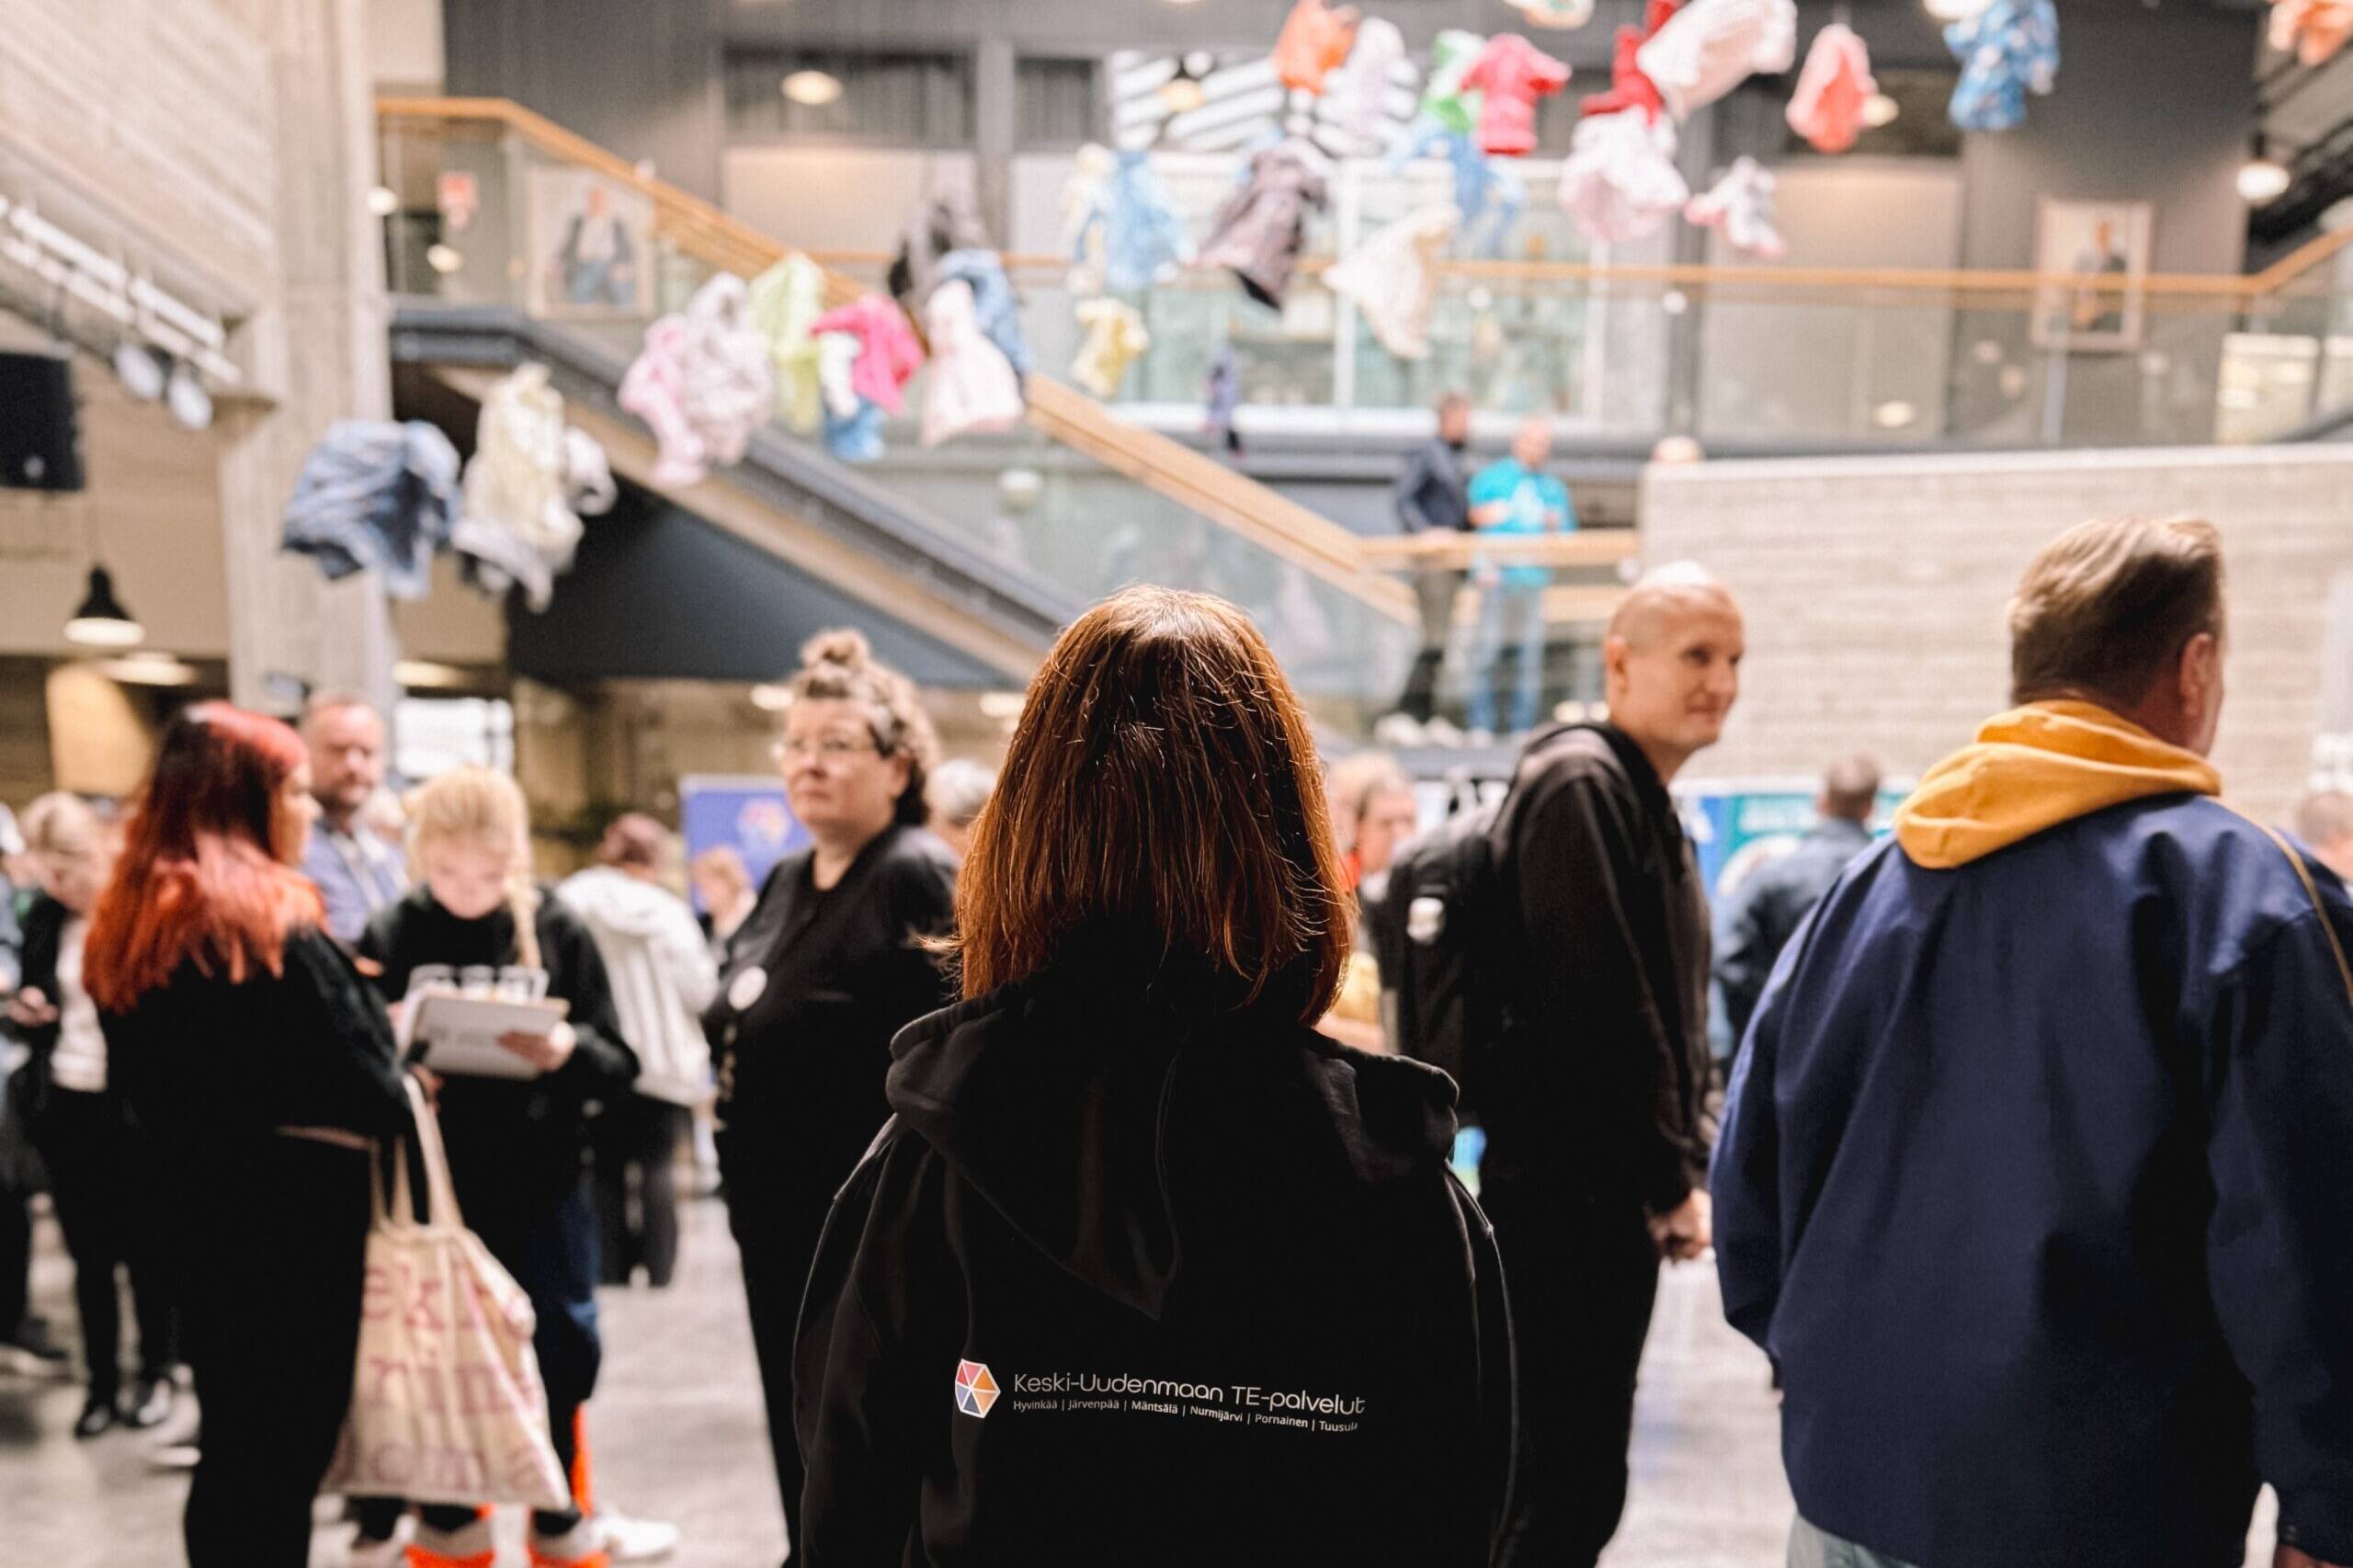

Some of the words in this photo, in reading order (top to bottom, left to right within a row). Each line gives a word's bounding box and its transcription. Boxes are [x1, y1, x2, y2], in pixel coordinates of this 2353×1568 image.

[1014, 1372, 1223, 1403] Keski-Uudenmaan
[1231, 1385, 1366, 1415] TE-palvelut
[1013, 1399, 1058, 1413] Hyvinkää
[1067, 1399, 1120, 1411] Järvenpää
[1131, 1400, 1178, 1415] Mäntsälä
[1189, 1405, 1244, 1423] Nurmijärvi
[1256, 1413, 1309, 1428] Pornainen
